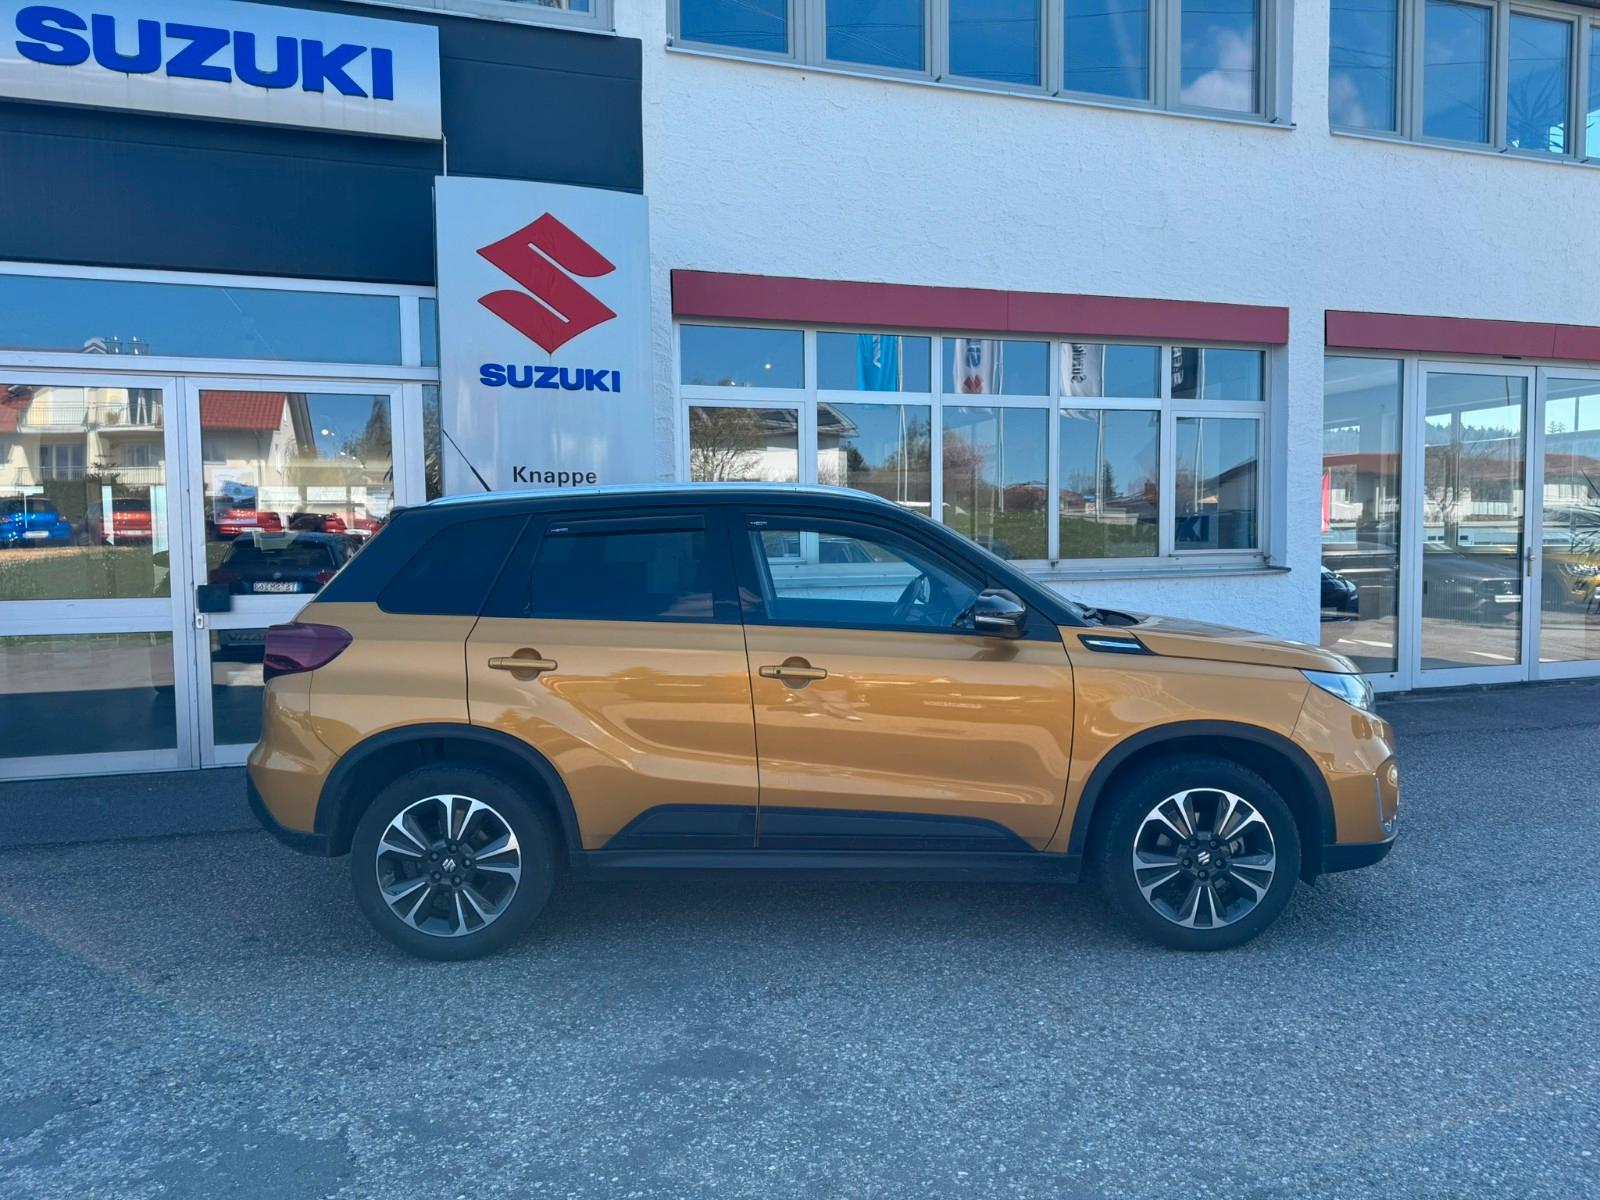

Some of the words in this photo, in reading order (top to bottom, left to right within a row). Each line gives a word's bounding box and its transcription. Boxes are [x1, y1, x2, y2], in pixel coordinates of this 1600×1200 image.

[15, 5, 394, 100] SUZUKI
[480, 363, 621, 392] SUZUKI
[513, 466, 597, 487] Knappe
